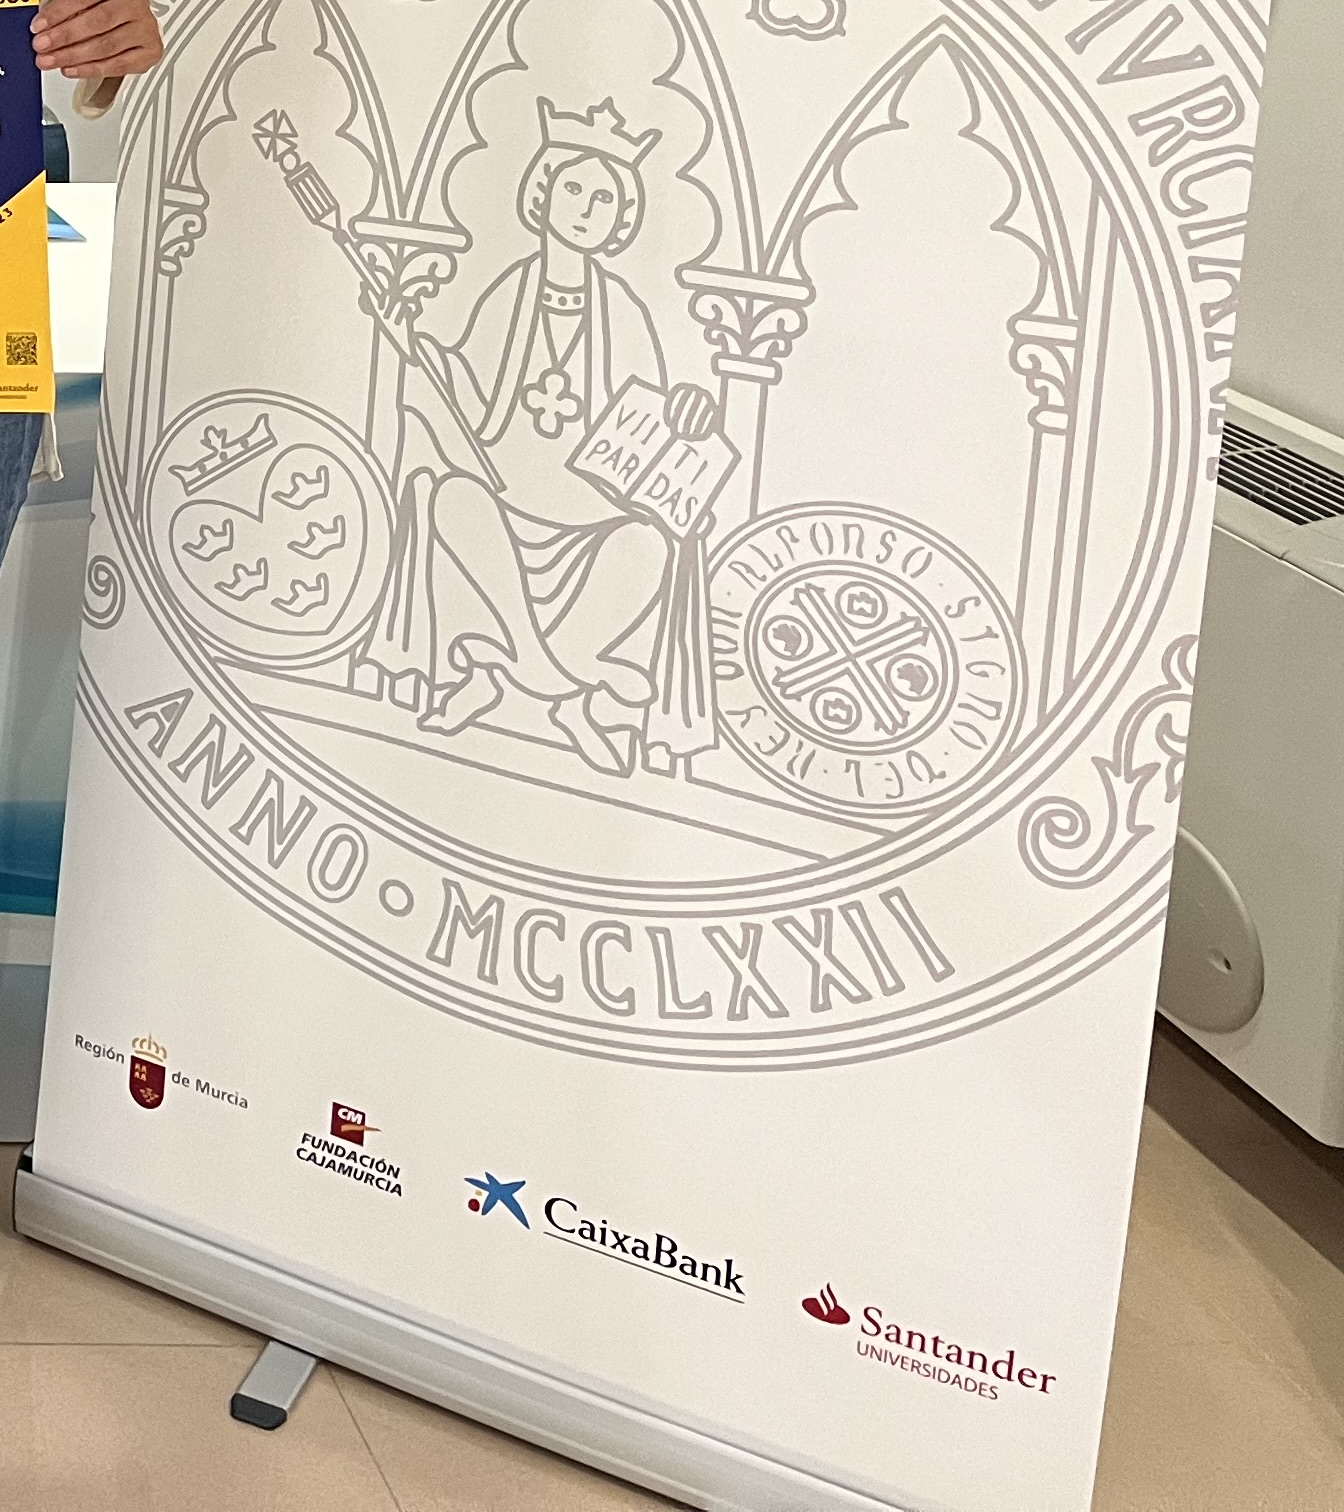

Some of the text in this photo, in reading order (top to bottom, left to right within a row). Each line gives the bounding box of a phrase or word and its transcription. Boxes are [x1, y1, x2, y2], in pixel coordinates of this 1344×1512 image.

[616, 403, 660, 446] VII
[584, 438, 641, 485] PAR
[680, 443, 709, 486] TI
[642, 472, 700, 528] DAS
[124, 687, 955, 1022] ANNO MCCLXXII
[74, 1034, 249, 1109] Región de Murcia
[337, 1107, 363, 1125] CM
[296, 1147, 404, 1198] CAJAMURCIA
[301, 1133, 401, 1180] FUNDACIÓN
[544, 1196, 746, 1297] CaixaBank
[856, 1339, 1000, 1401] UNIVERSIDADES
[859, 1304, 1058, 1396] Santander
